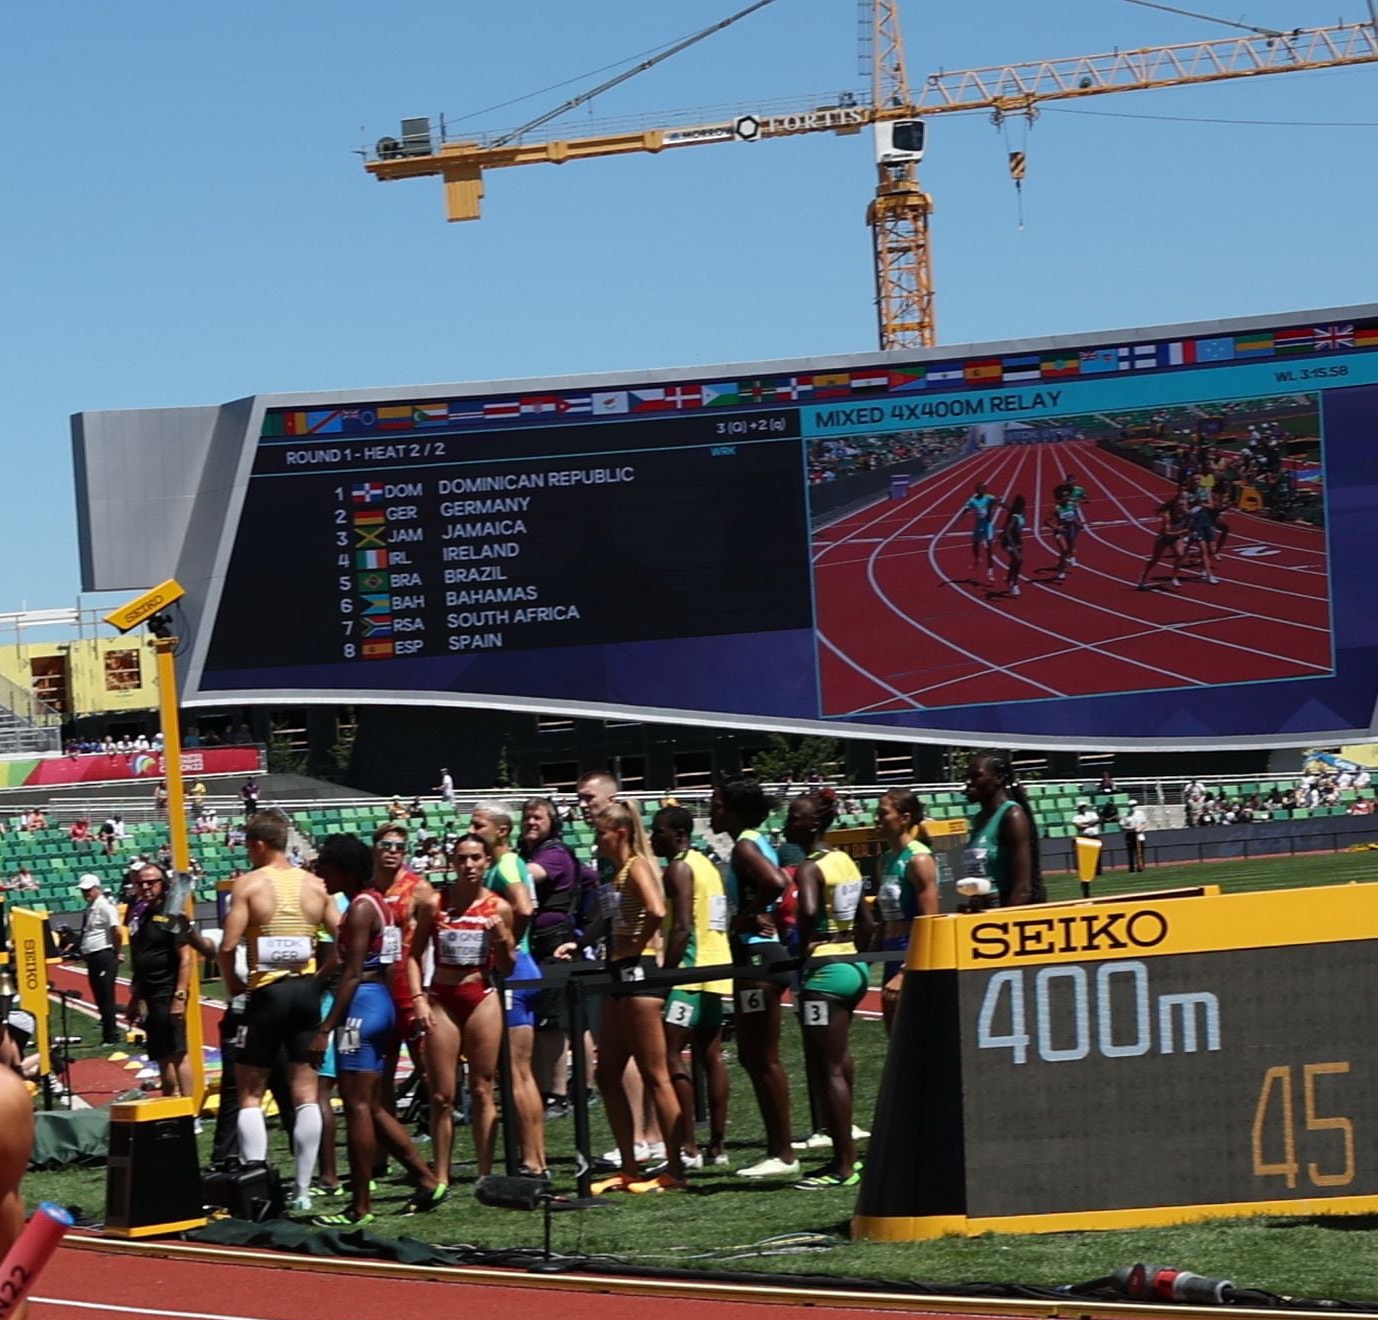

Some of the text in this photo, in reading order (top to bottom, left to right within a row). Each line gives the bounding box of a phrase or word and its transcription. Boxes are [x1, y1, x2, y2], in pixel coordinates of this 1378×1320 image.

[768, 108, 862, 132] FORTIS
[1275, 371, 1297, 382] WL
[816, 391, 1062, 428] MIXED 4X400M RELAY
[286, 449, 341, 464] ROUND
[364, 445, 406, 460] HEAT
[410, 444, 420, 457] 2
[434, 442, 445, 455] 2
[335, 467, 635, 501] 1 DOM DOMINICAN REPUBLIC
[335, 497, 531, 524] 2 GER GERMANY
[336, 519, 527, 546] 3 JAM JAMAICA
[338, 542, 520, 568] 4 IRL IRELAND
[339, 566, 508, 591] 5 BRA BRAZIL
[124, 595, 164, 622] SEIKO
[340, 586, 538, 613] 6 BAH BAHAMAS
[342, 604, 581, 636] 7 RSA SOUTH AFRICA
[343, 632, 503, 659] 8 ESP SPAIN
[971, 910, 1168, 960] SEIKO
[24, 939, 38, 990] SEIKO
[271, 951, 298, 962] GER
[677, 1006, 684, 1020] 3
[749, 993, 759, 1008] 6
[812, 1005, 820, 1021] 3
[977, 960, 1222, 1065] 400m
[1252, 1061, 1356, 1189] 45
